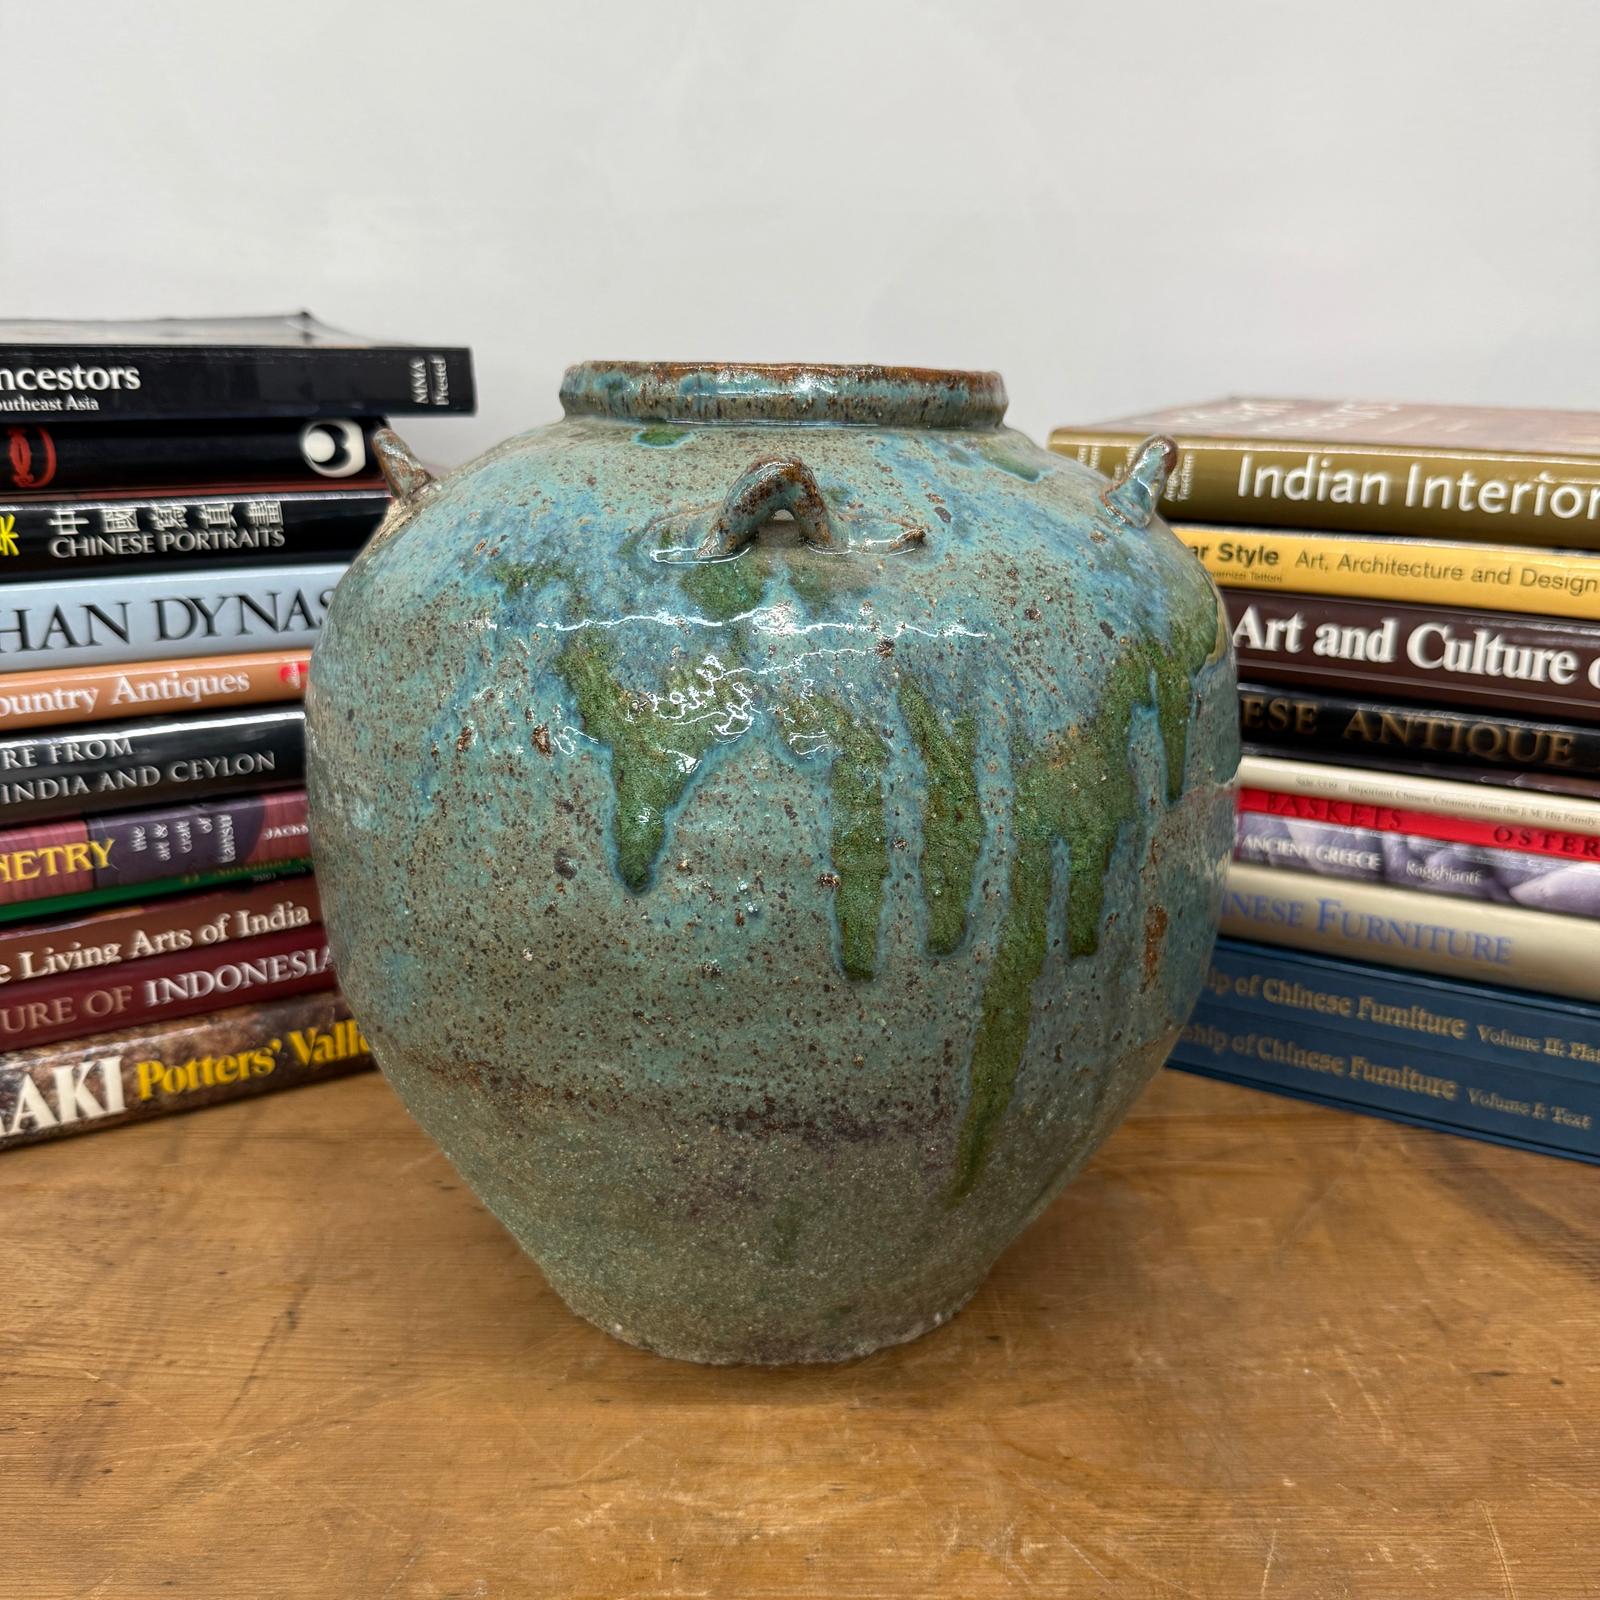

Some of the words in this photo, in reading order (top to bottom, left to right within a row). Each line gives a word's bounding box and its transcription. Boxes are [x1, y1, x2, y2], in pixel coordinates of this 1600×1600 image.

[0, 363, 141, 391] ncestors
[0, 394, 63, 411] utheast
[65, 393, 100, 411] Asia
[1237, 453, 1391, 507] Indian
[1404, 462, 1600, 520] Interior
[49, 531, 157, 559] CHINESE
[159, 525, 286, 553] PORTRAITS
[1217, 542, 1279, 569] Style
[1336, 552, 1464, 582] Architecture
[1470, 566, 1512, 586] and
[1519, 567, 1599, 597] Design
[0, 600, 130, 654] HAN
[1232, 604, 1305, 654] Art
[1313, 617, 1398, 663] and
[1406, 622, 1580, 686] Culture
[111, 671, 250, 704] Antiques
[3, 745, 38, 770] RE
[48, 738, 134, 764] FROM
[1240, 694, 1318, 735] ESE
[1343, 709, 1576, 768] ANTIQUE
[0, 775, 91, 805] INDIA
[98, 765, 161, 793] AND
[167, 750, 277, 783] CEYLON
[1316, 845, 1382, 873] GREECE
[17, 941, 122, 979] Living
[129, 929, 194, 959] Arts
[195, 913, 231, 945] of
[234, 901, 312, 938] India
[1315, 896, 1515, 966] FURNITURE
[1, 996, 77, 1034] URE
[83, 985, 133, 1017] OF
[1235, 975, 1262, 997] of
[1263, 977, 1353, 1018] Chinese
[1357, 995, 1468, 1040] Furniture
[1476, 1024, 1541, 1054] Volume
[0, 1055, 128, 1138] AKI
[1231, 1033, 1257, 1055] of
[1257, 1036, 1346, 1076] Chinese
[1349, 1055, 1459, 1100] Furniture
[1466, 1087, 1530, 1117] Volume
[1550, 1105, 1592, 1131] Text
